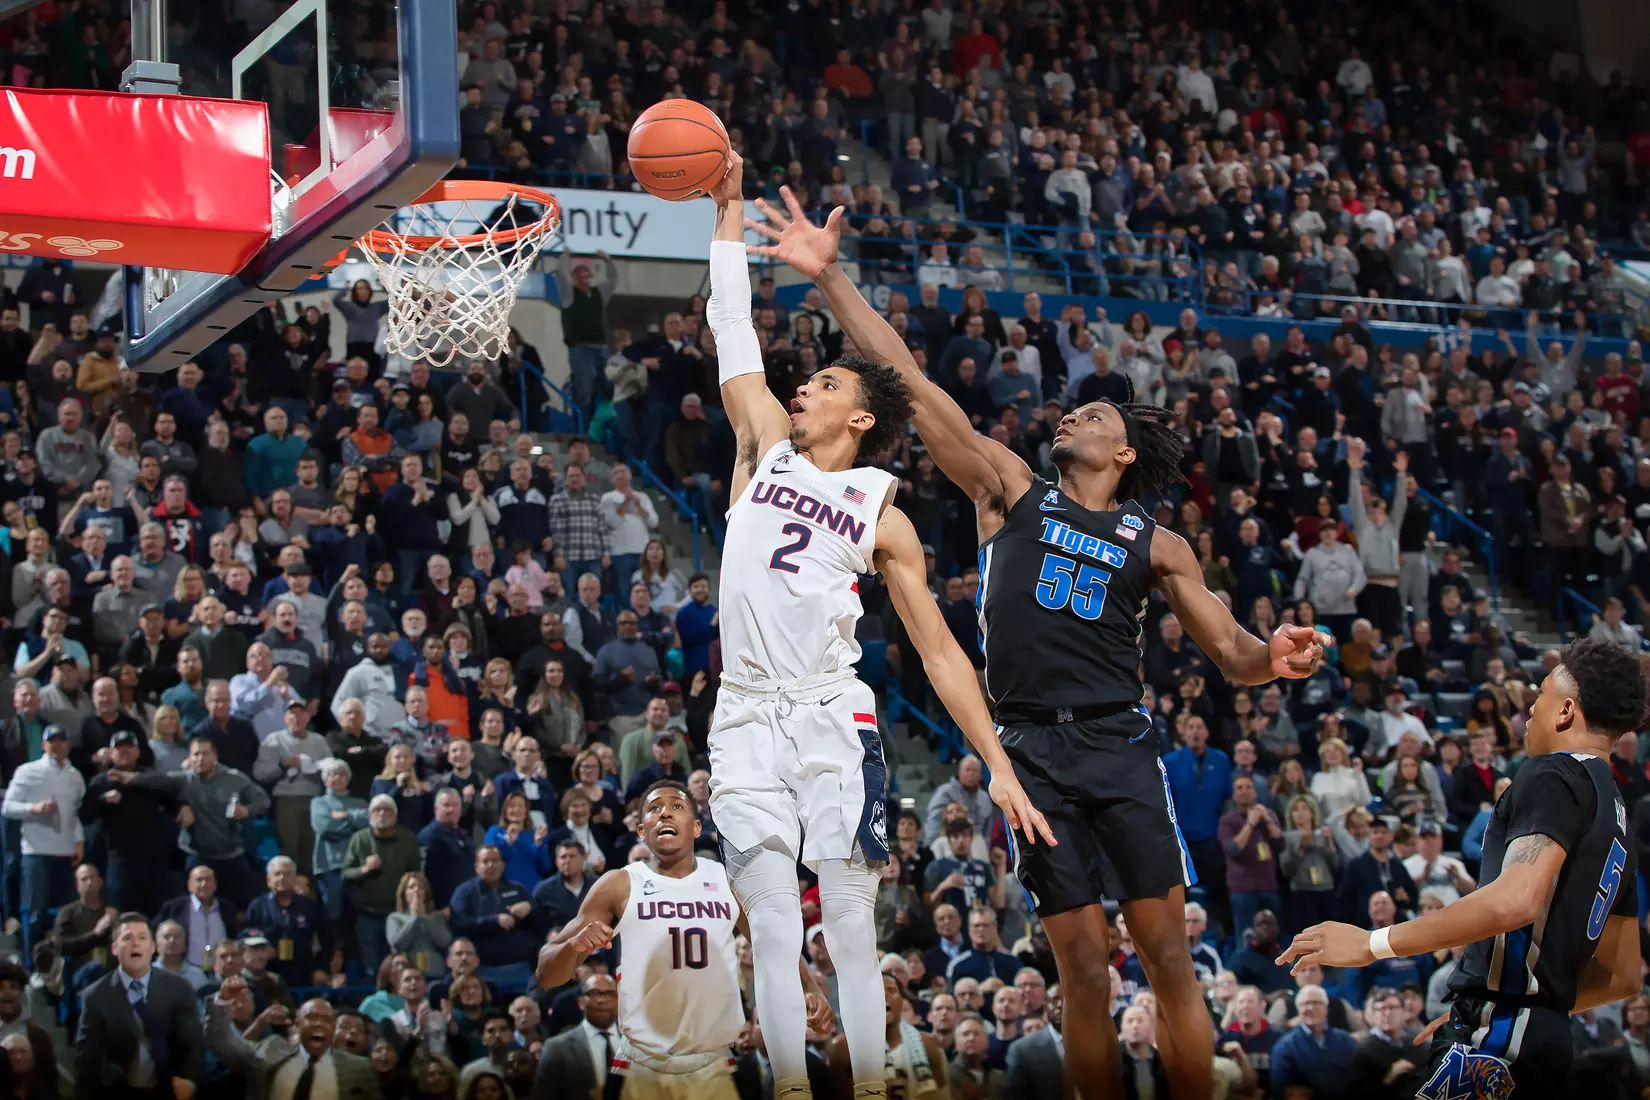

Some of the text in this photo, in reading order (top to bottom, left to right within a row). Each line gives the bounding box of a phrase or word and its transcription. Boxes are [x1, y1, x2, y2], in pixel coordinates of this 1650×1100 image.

[652, 169, 686, 178] UCONN
[560, 201, 648, 249] nity
[750, 481, 867, 546] UCONN
[769, 522, 813, 575] 2
[1039, 516, 1128, 569] Tigers
[1035, 552, 1112, 620] 55
[637, 901, 732, 920] UCONN
[1586, 837, 1628, 941] 5
[668, 926, 709, 970] 10
